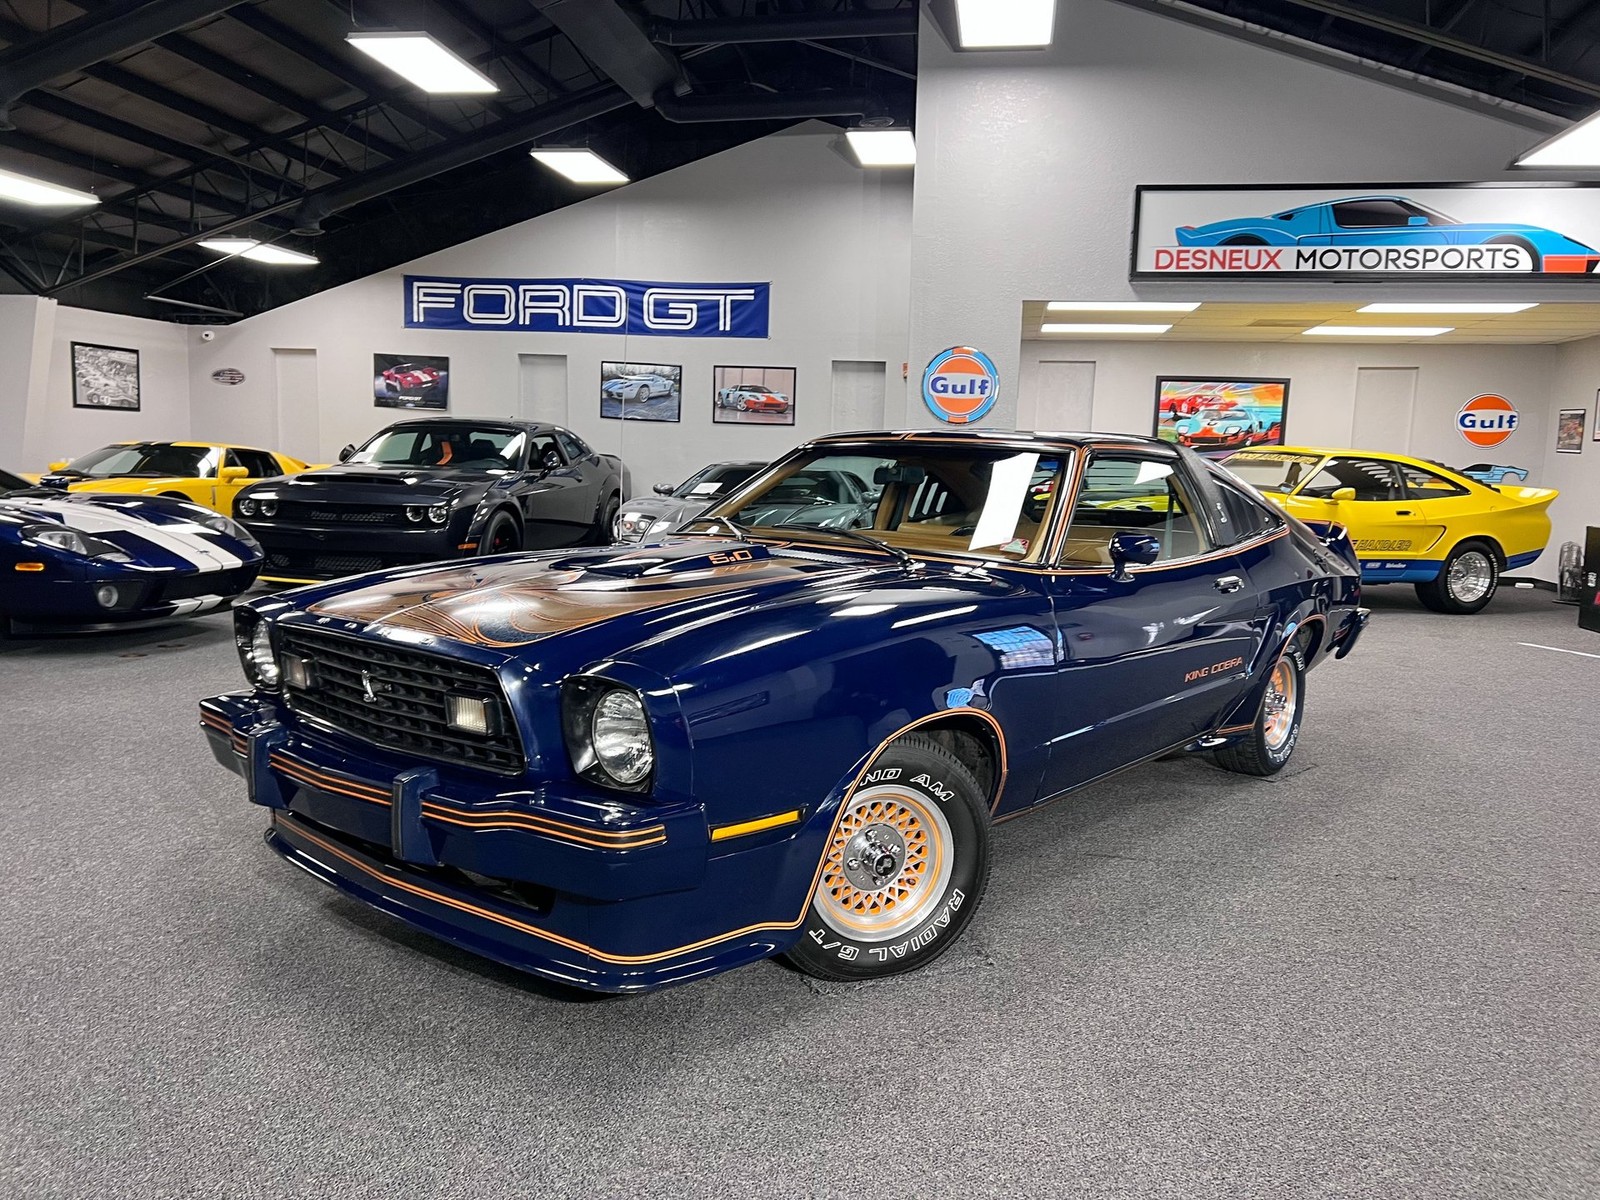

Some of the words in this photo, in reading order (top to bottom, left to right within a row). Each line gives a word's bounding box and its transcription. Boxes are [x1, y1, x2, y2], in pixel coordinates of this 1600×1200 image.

[1155, 248, 1283, 270] DESNEUX
[1296, 248, 1520, 270] MOTORSPORTS
[413, 281, 627, 328] FORD
[643, 288, 755, 331] GT
[930, 376, 990, 395] Gulf
[1459, 412, 1517, 429] Gulf
[708, 550, 753, 565] 5.0
[1184, 666, 1209, 683] KING
[1211, 656, 1243, 674] COBRA
[909, 773, 955, 802] AM
[868, 888, 966, 962] RADIAL
[808, 928, 860, 962] G/T
